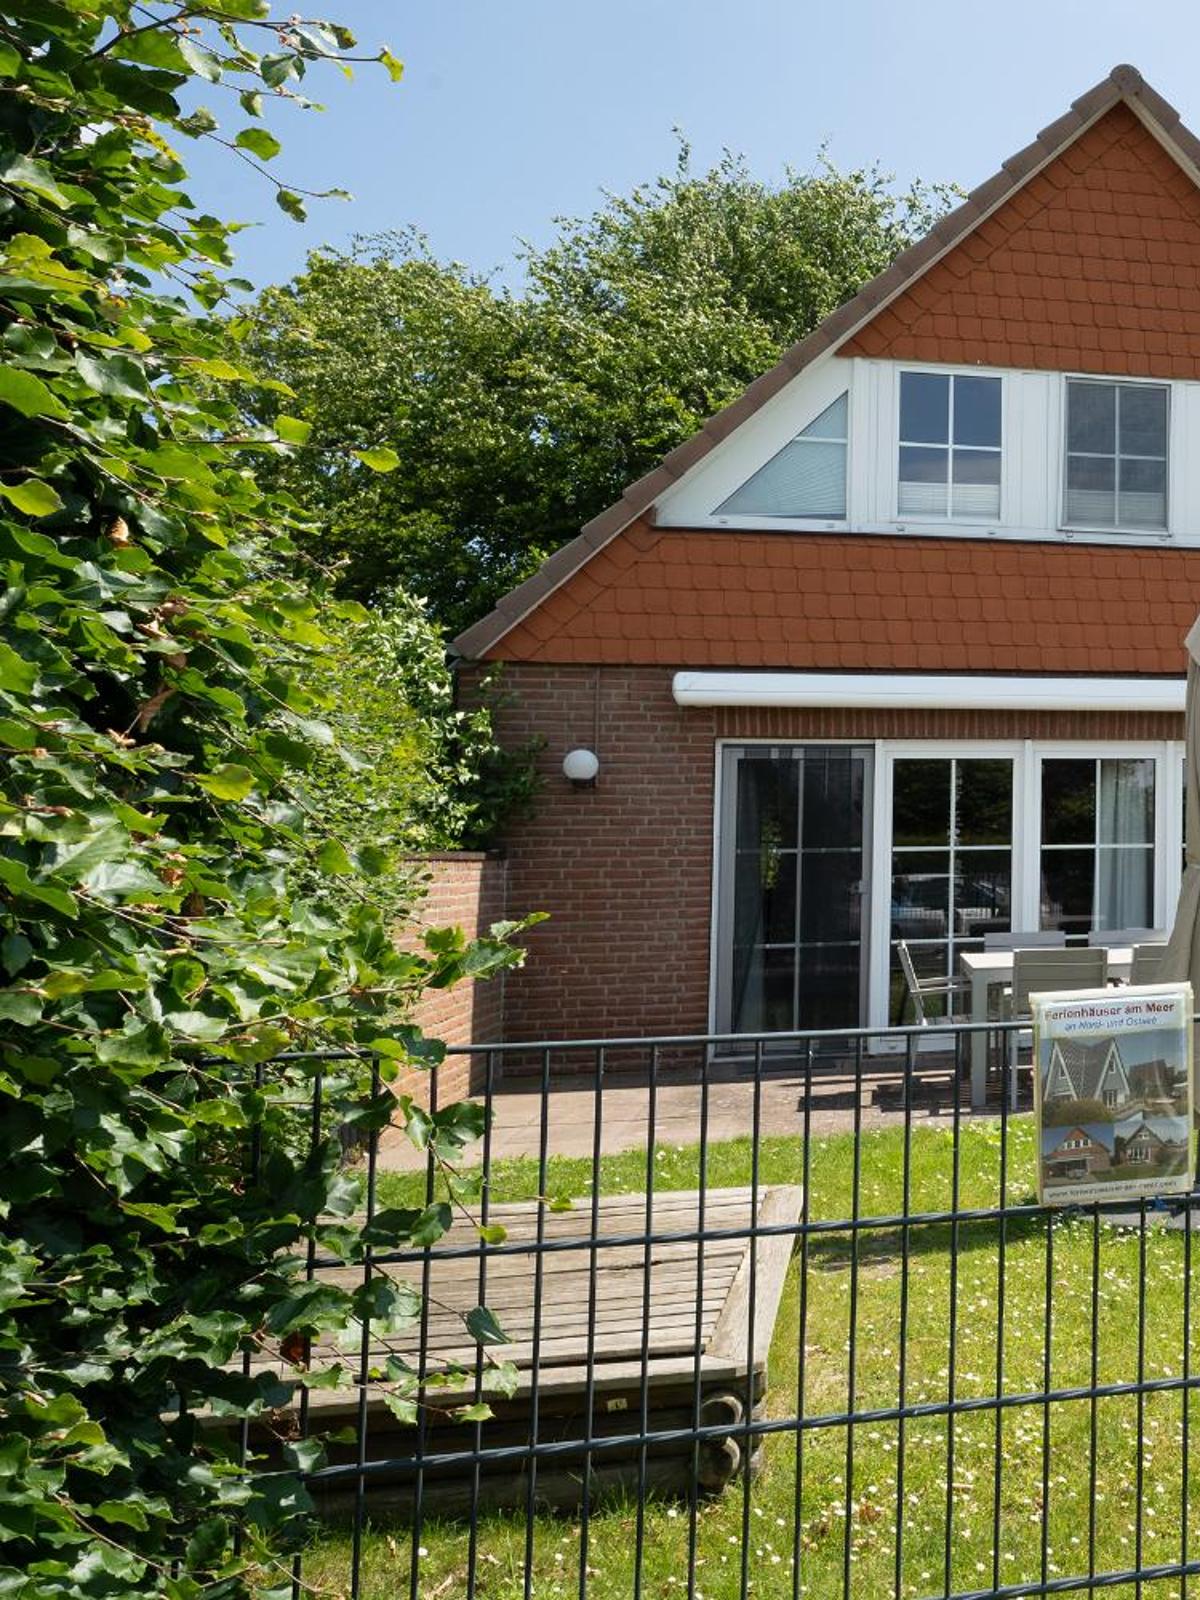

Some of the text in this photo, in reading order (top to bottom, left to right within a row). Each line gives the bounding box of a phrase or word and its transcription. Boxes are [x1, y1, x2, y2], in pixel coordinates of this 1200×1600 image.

[1045, 1002, 1175, 1020] Ferienhäuser am Meer
